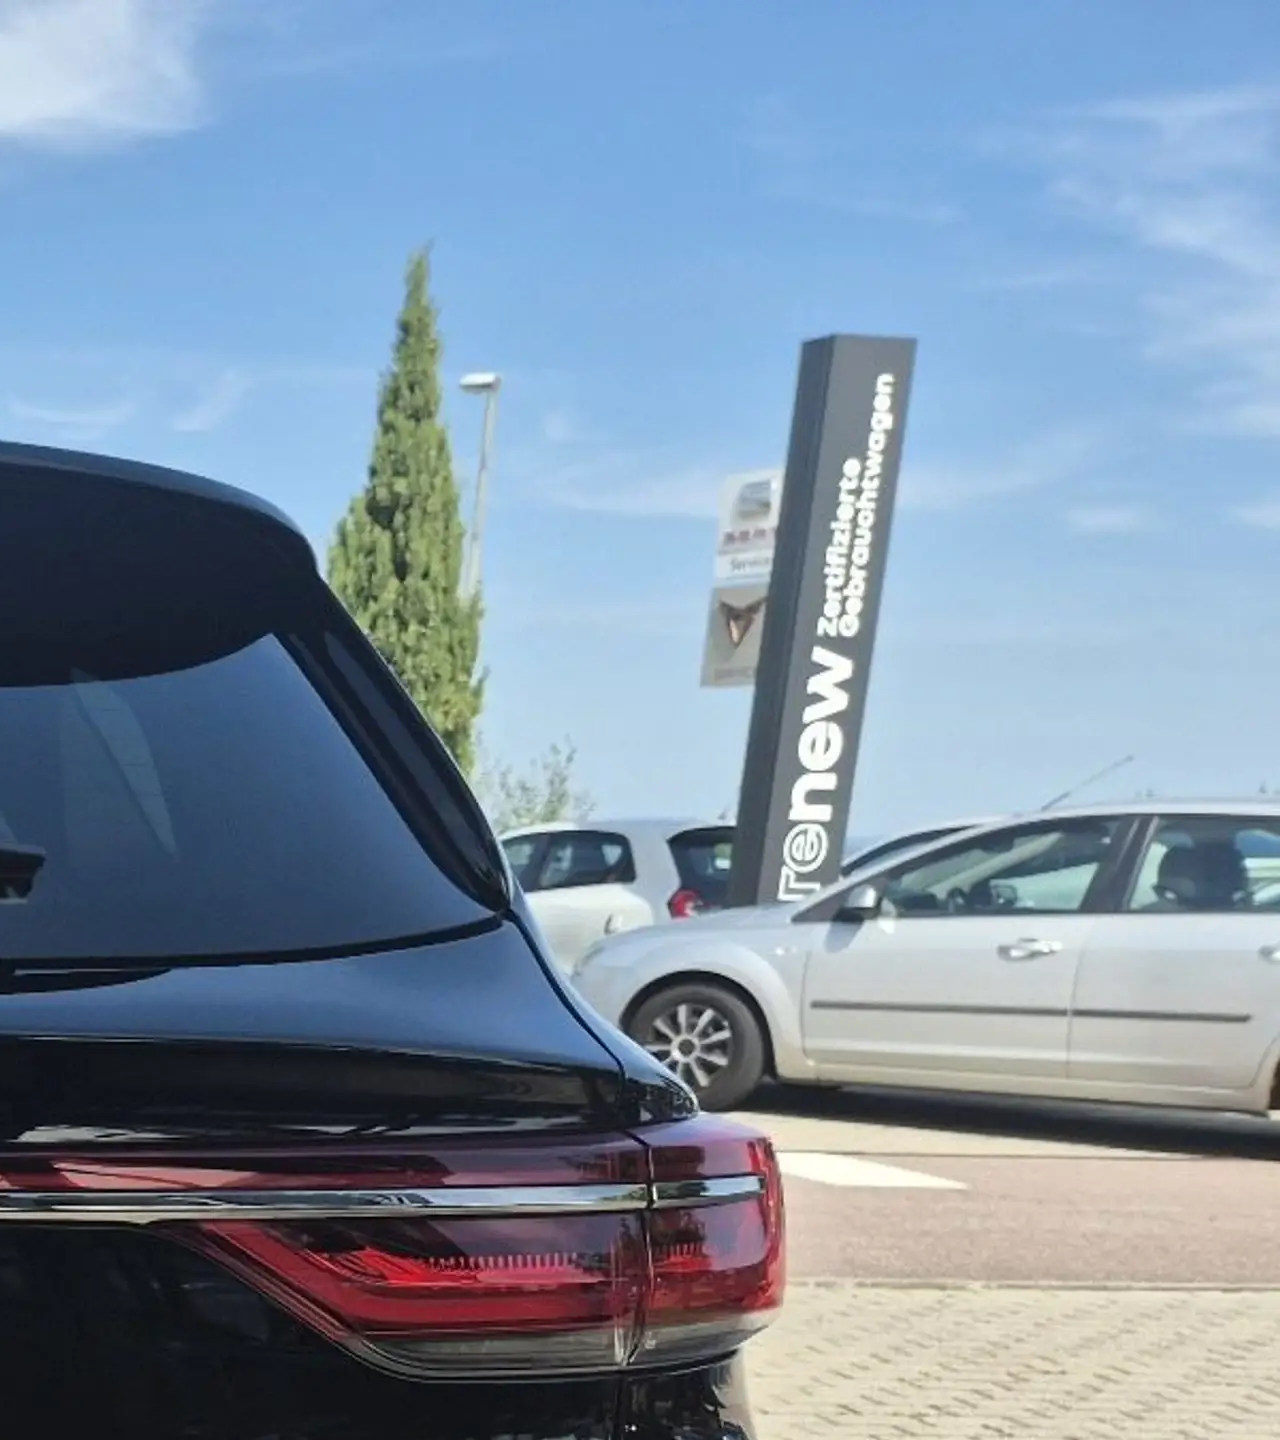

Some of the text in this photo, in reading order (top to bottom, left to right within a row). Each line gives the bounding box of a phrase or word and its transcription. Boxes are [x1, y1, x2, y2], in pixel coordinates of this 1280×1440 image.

[817, 458, 861, 637] Zertifizierte
[839, 373, 894, 637] Gebrauchtwagen
[777, 646, 853, 902] renew
